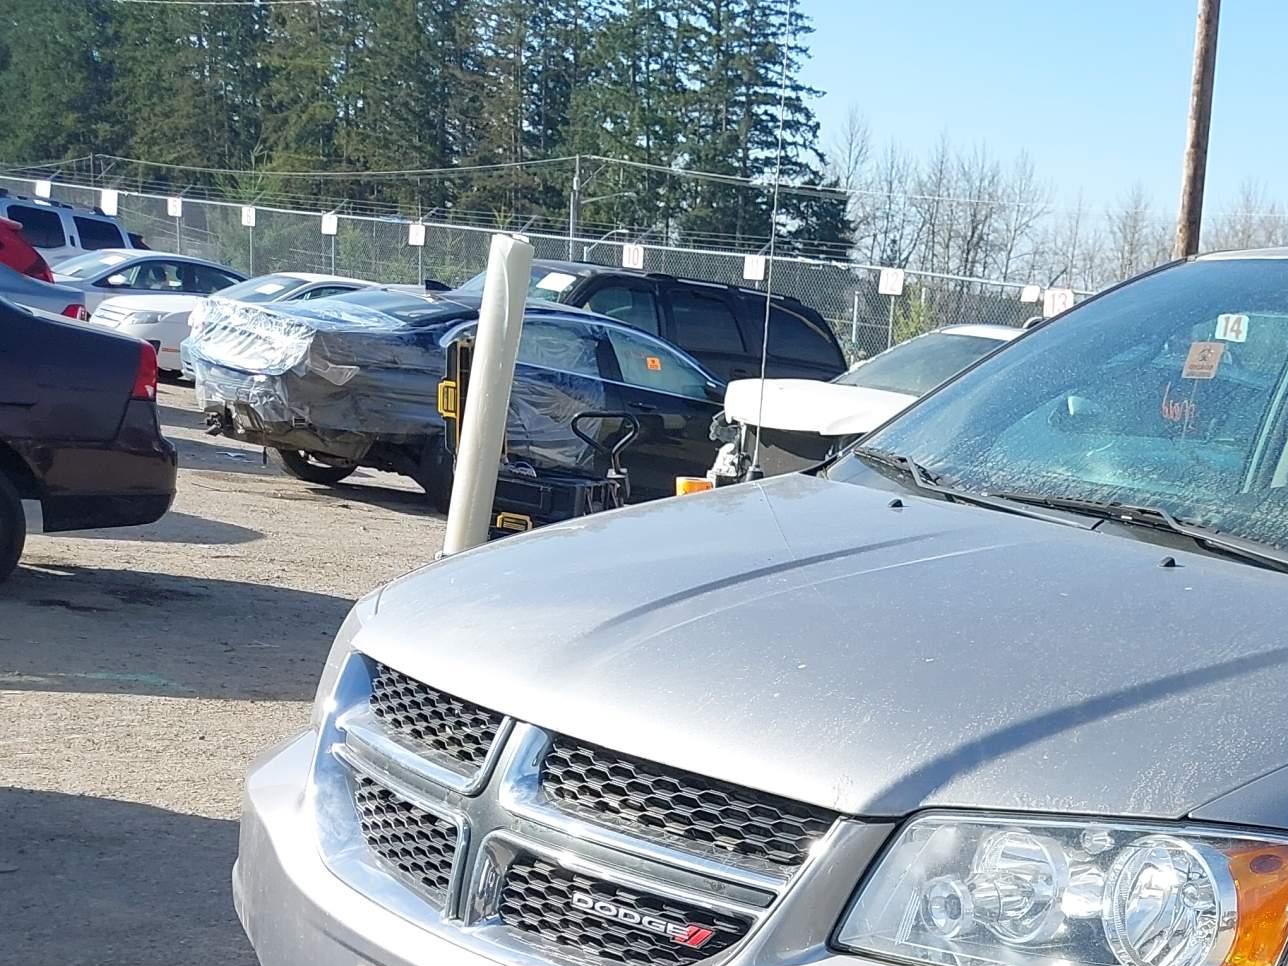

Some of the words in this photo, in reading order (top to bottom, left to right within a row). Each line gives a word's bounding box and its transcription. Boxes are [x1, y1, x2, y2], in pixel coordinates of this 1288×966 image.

[627, 246, 640, 266] 10
[884, 271, 900, 292] 12
[1223, 316, 1243, 340] 14
[572, 890, 690, 940] DODGE
